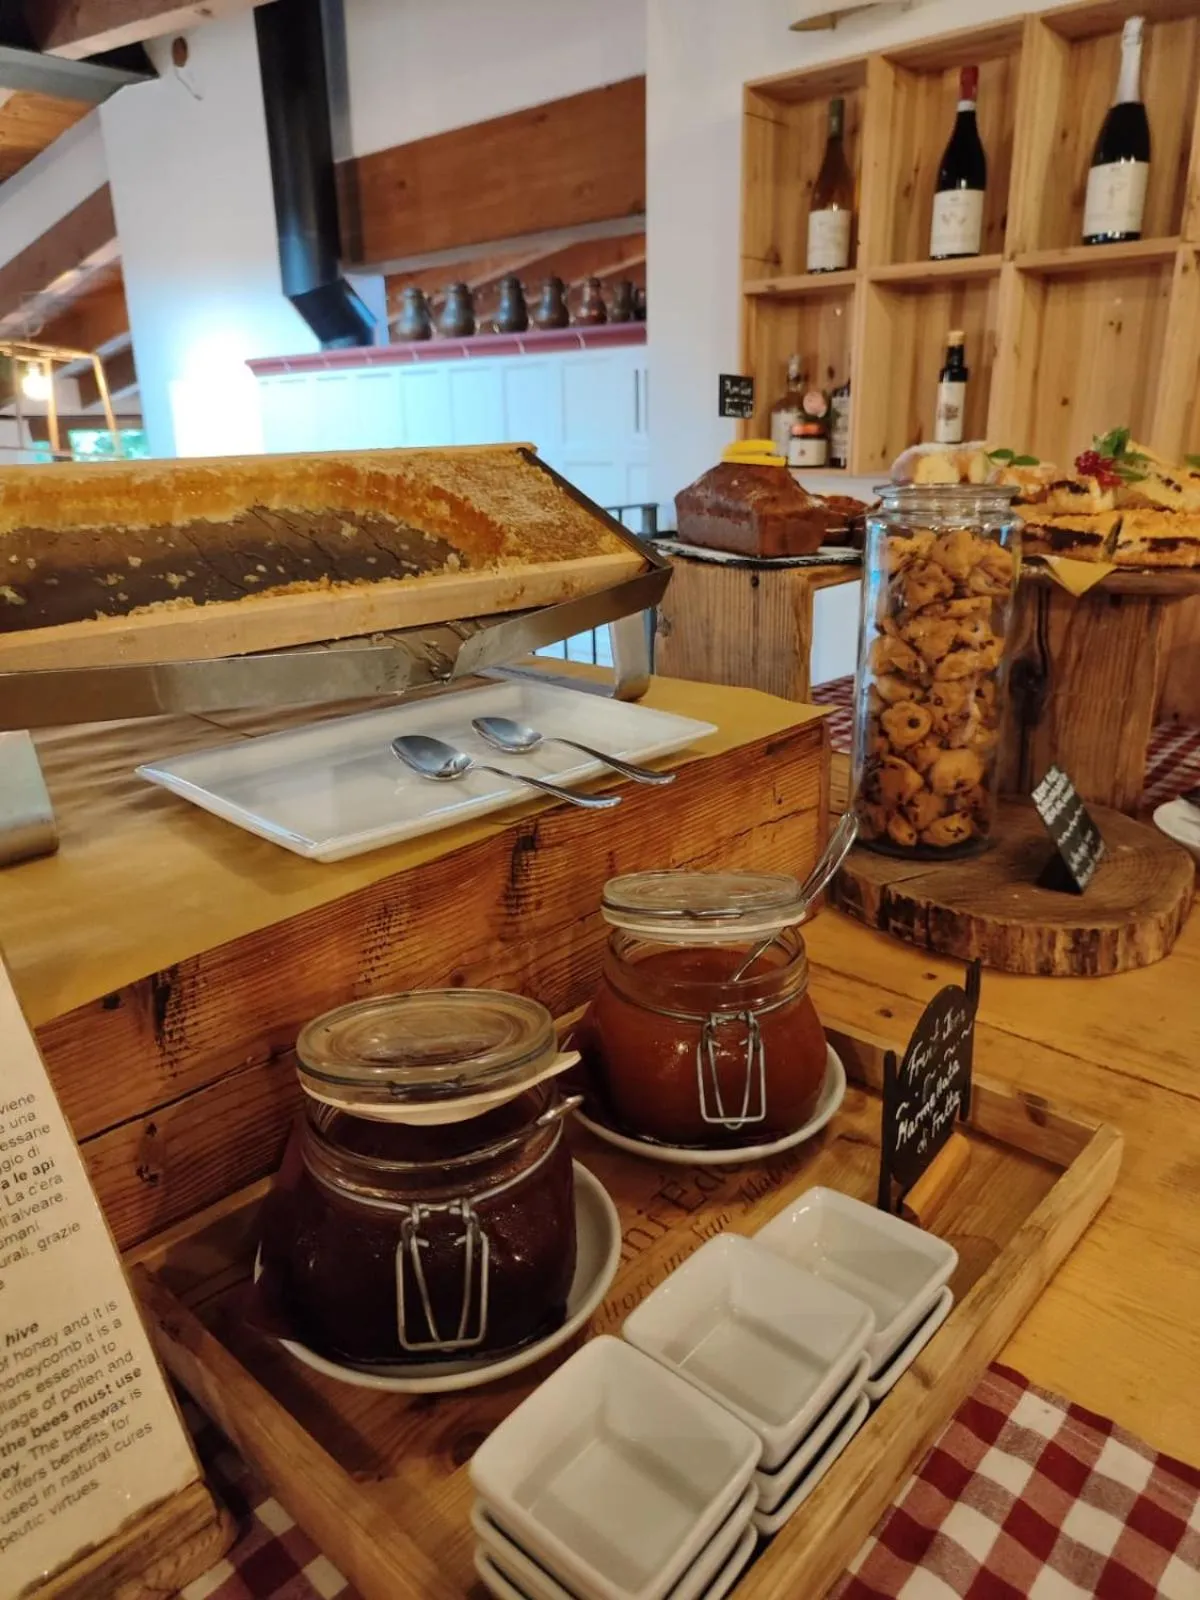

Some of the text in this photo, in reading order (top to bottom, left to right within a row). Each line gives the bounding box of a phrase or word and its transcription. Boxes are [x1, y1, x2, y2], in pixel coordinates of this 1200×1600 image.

[9, 1112, 36, 1129] una
[0, 1144, 40, 1175] gio di
[13, 1171, 28, 1184] le
[31, 1156, 55, 1176] api
[4, 1191, 24, 1206] La
[37, 1222, 81, 1252] grazie
[5, 1322, 39, 1348] hive
[12, 1331, 58, 1363] honey
[63, 1312, 90, 1337] and
[92, 1307, 102, 1320] it
[104, 1300, 118, 1313] is
[84, 1332, 95, 1345] it
[96, 1324, 110, 1338] is
[112, 1318, 122, 1329] a
[35, 1348, 100, 1393] essential
[101, 1341, 116, 1355] to
[42, 1391, 57, 1411] of
[60, 1368, 104, 1403] pollen
[107, 1349, 134, 1374] and
[1, 1367, 142, 1457] the bees must use
[28, 1438, 60, 1461] The
[62, 1398, 127, 1441] beeswax
[130, 1387, 142, 1400] is
[0, 1422, 153, 1525] used in natural cures
[2, 1413, 130, 1501] offers benefits for
[49, 1478, 100, 1516] virtues
